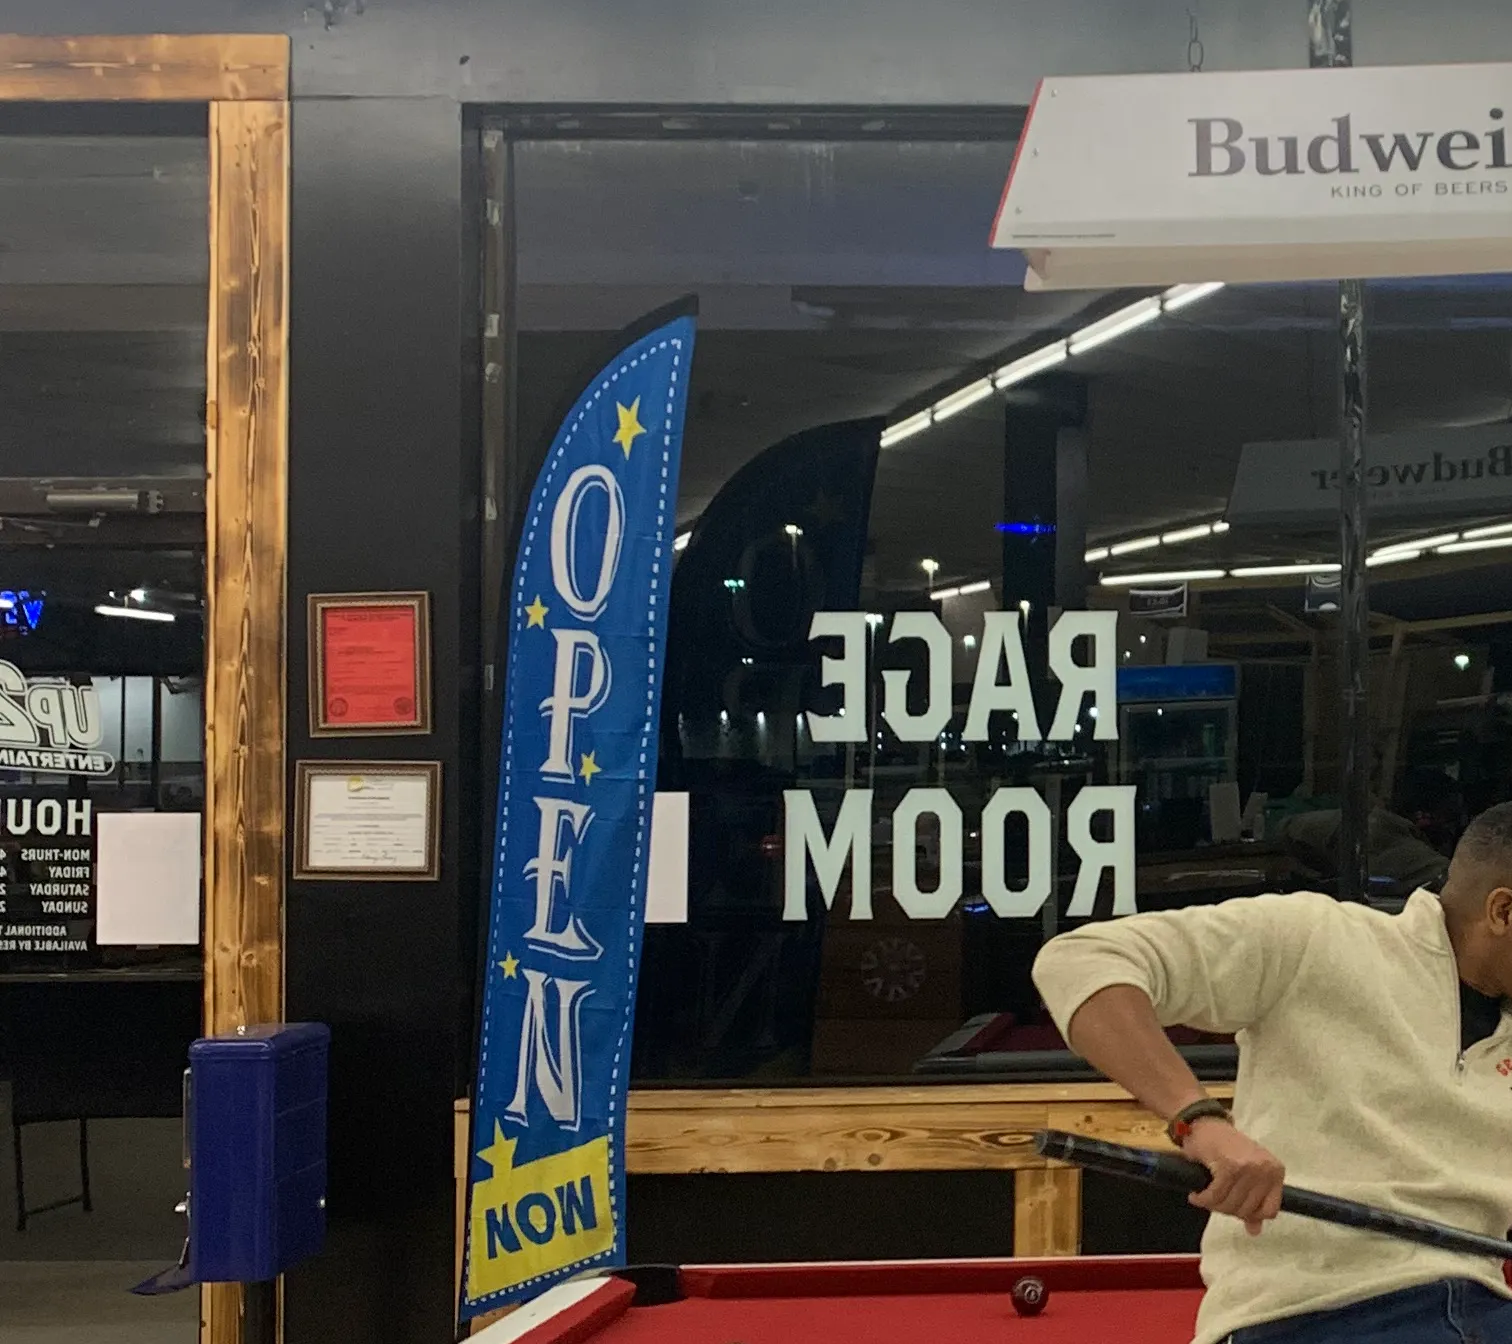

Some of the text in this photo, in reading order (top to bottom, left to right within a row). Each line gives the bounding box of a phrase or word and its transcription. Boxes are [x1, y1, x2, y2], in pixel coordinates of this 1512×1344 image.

[1331, 180, 1509, 199] KING OF BEERS
[504, 464, 626, 1132] OPEN
[485, 1174, 598, 1261] NOW
